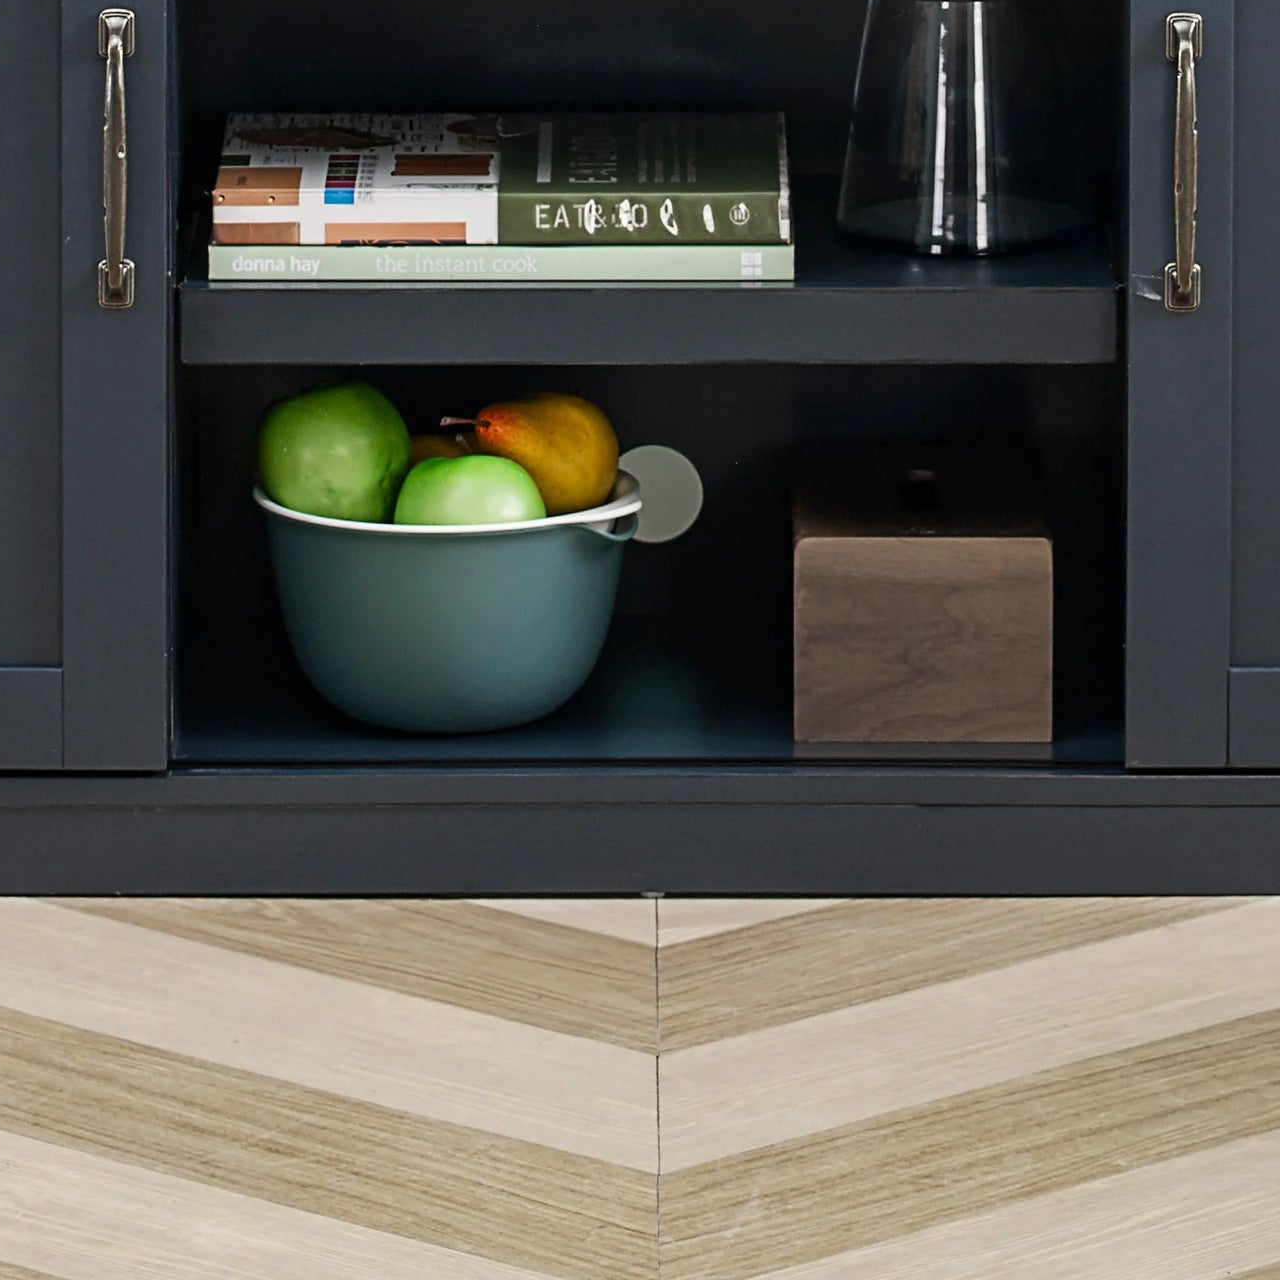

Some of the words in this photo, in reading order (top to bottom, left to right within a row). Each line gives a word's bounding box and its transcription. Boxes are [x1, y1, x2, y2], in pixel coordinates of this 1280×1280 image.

[231, 254, 285, 274] donna
[289, 254, 321, 278] hay
[376, 254, 409, 273] the
[414, 254, 487, 273] instant
[492, 254, 539, 273] cook
